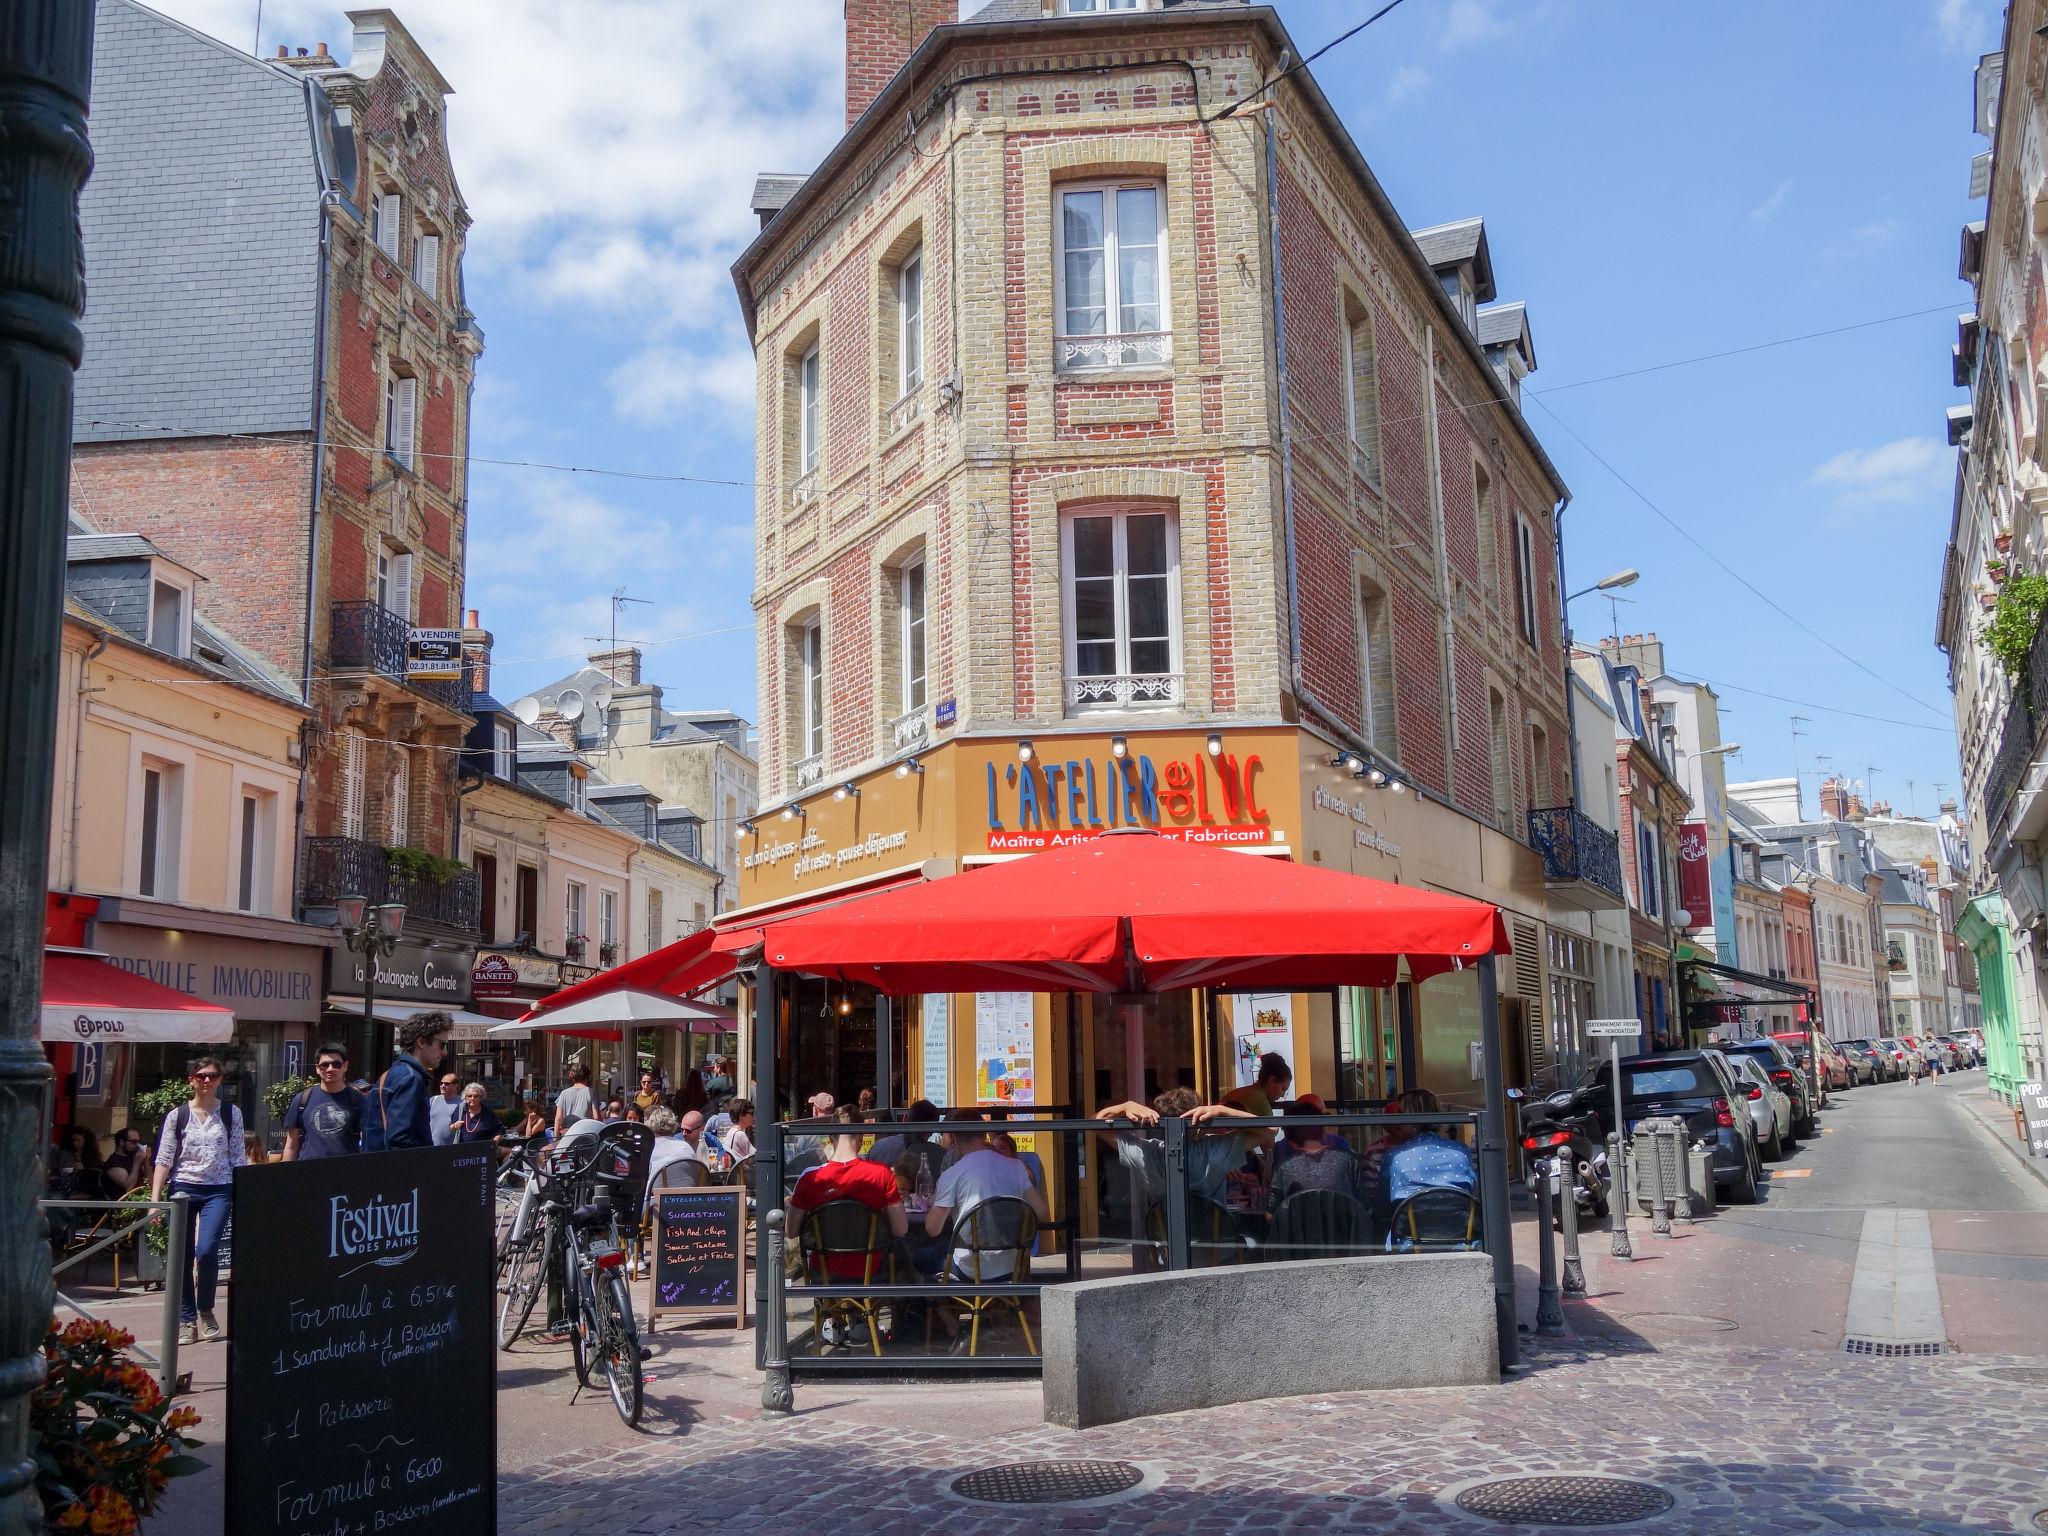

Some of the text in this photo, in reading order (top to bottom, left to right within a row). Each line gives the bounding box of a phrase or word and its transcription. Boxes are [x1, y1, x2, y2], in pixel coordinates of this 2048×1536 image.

[411, 631, 460, 639] A VENDRE
[421, 642, 449, 655] Century 21
[987, 753, 1267, 827] L'ATELIER de LUC
[990, 834, 1045, 848] Maître
[1185, 829, 1265, 844] Fabricant
[770, 840, 794, 864] glaces
[810, 852, 831, 870] resto
[837, 844, 864, 869] pause
[865, 831, 908, 858] déjeuner
[213, 964, 312, 1001] IMMOBILIER
[355, 963, 364, 981] la
[424, 961, 457, 991] Centrale
[2021, 1083, 2042, 1097] POP
[453, 1157, 480, 1167] L'ESPRIT
[481, 1167, 487, 1181] DU
[329, 1187, 420, 1258] Festival
[668, 1211, 726, 1219] SUGGESTION
[666, 1226, 684, 1238] Fish
[359, 1236, 418, 1253] DES PAINS
[665, 1243, 689, 1251] Sauce
[667, 1253, 695, 1265] Salade
[698, 1253, 708, 1262] et
[289, 1284, 373, 1331] Formule
[382, 1291, 395, 1310] à
[272, 1349, 289, 1375] 1
[293, 1330, 366, 1369] Sandwich
[286, 1409, 301, 1439] 1
[277, 1460, 375, 1525] Formule
[381, 1464, 392, 1489] à
[374, 1504, 430, 1531] Boisson
